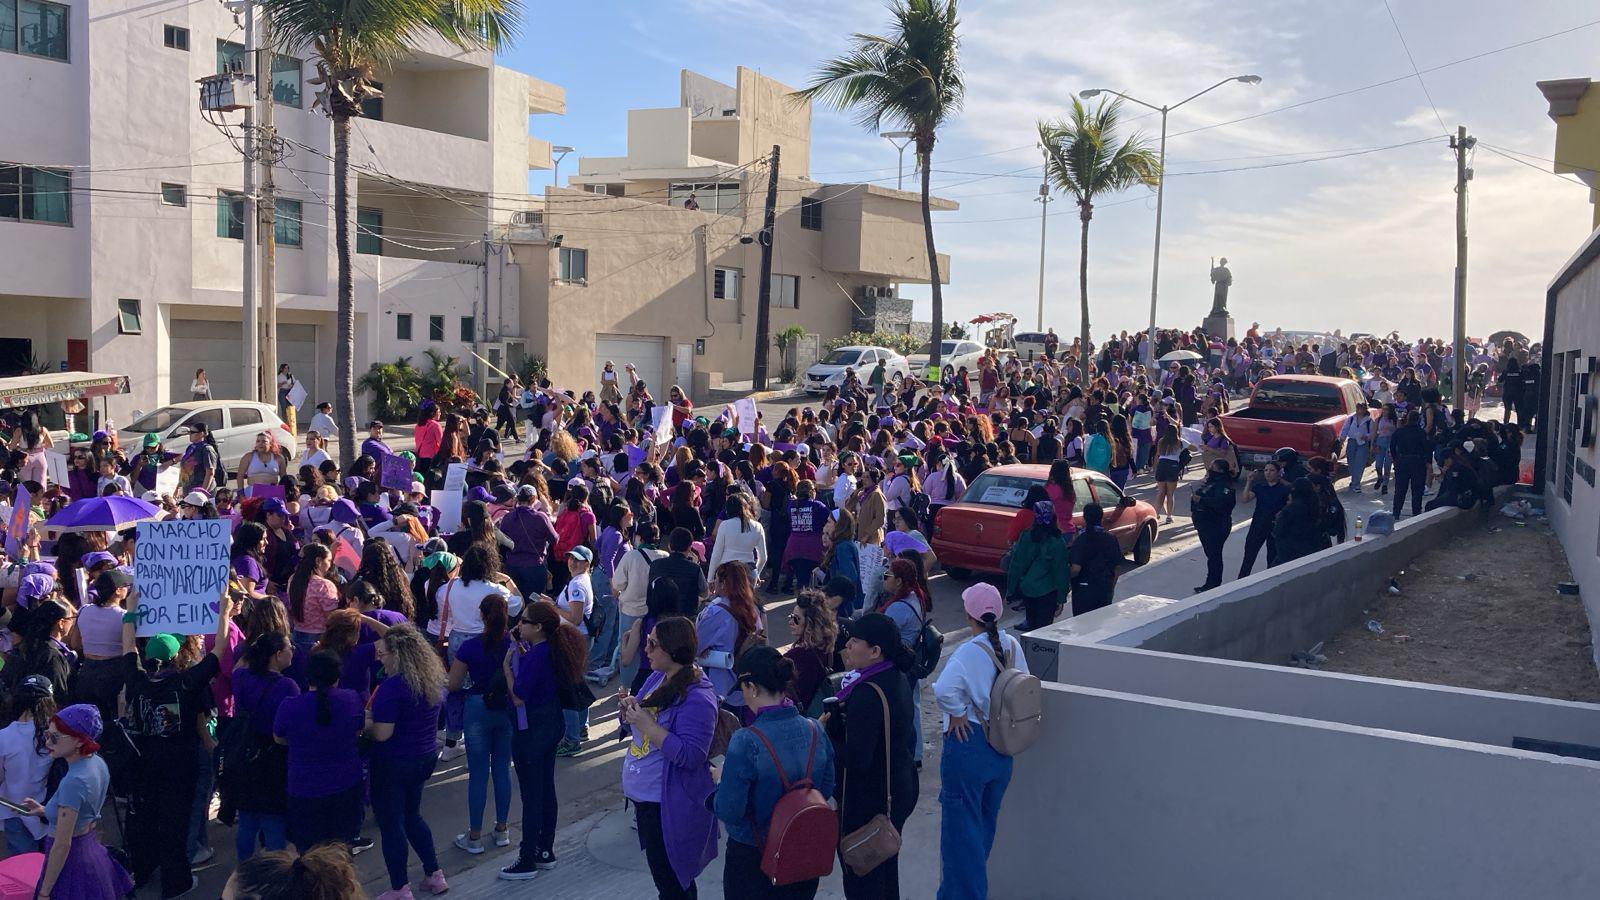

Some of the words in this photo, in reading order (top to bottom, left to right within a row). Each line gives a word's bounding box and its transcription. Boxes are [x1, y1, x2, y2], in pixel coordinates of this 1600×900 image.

[149, 522, 221, 539] MARCHO
[136, 542, 165, 561] CON
[170, 543, 191, 560] MI
[195, 542, 230, 560] HIJA
[138, 582, 162, 599] NO
[137, 603, 172, 626] POR
